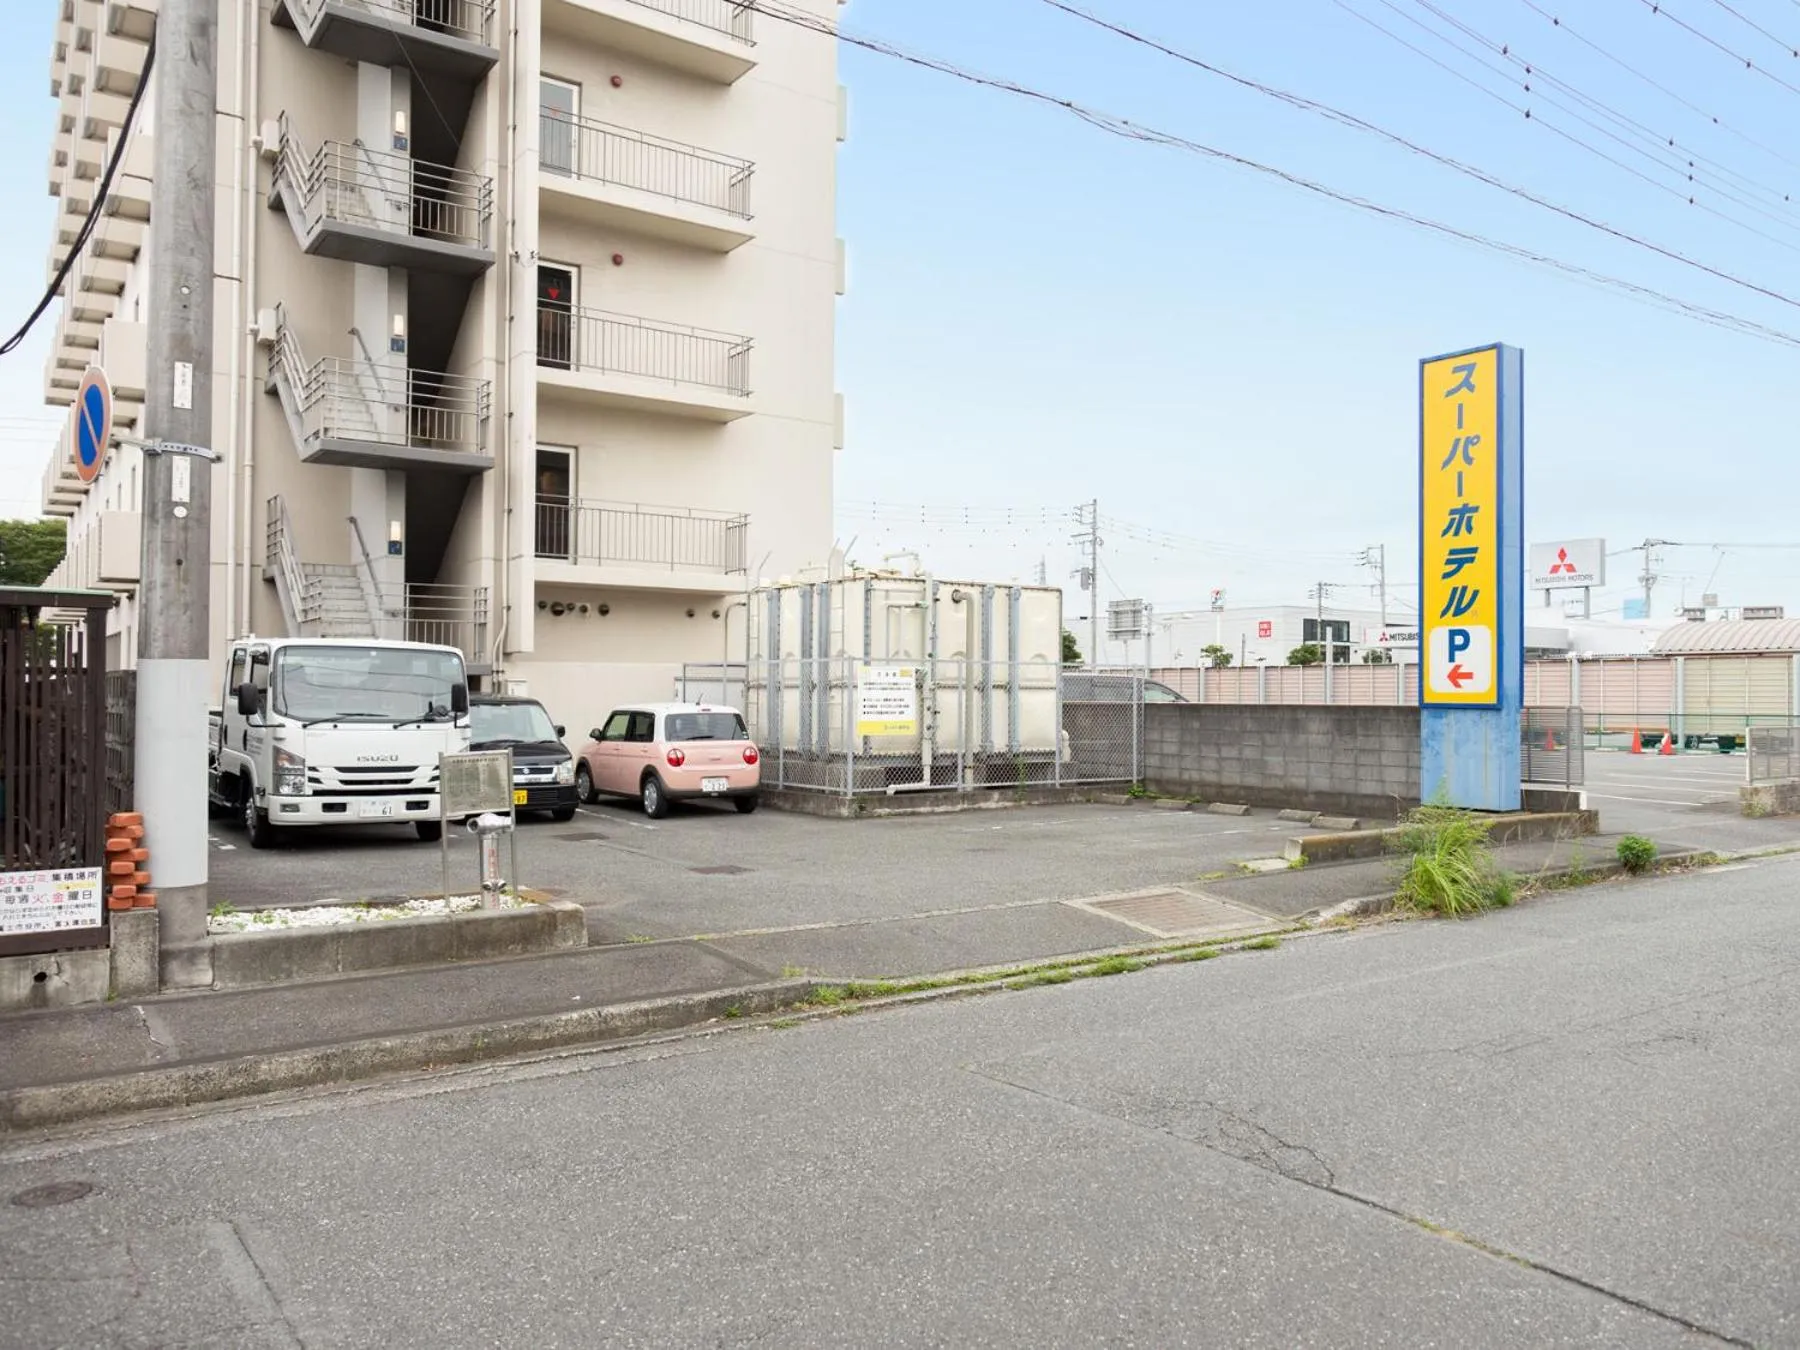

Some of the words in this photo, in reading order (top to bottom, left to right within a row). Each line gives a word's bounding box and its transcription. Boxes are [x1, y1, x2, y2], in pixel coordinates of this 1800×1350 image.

[1440, 361, 1481, 619] スーパーホテル
[1448, 628, 1470, 663] P
